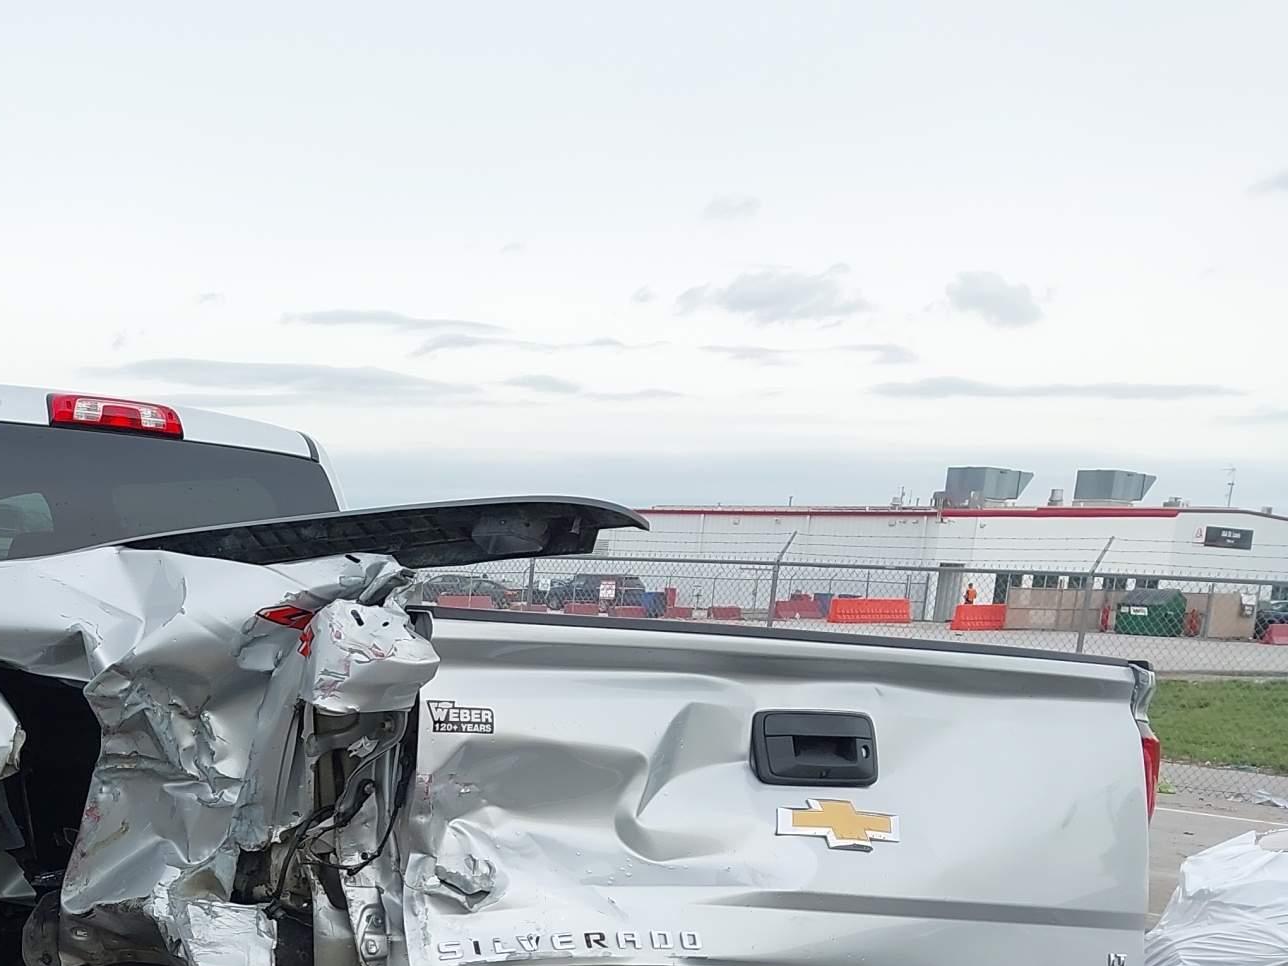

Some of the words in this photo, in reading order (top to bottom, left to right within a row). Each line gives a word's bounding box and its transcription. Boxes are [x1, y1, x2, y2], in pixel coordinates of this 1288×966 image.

[428, 702, 493, 723] WEBER
[434, 722, 459, 732] 120+
[460, 723, 492, 733] YEARS
[437, 930, 704, 961] SILVERADO
